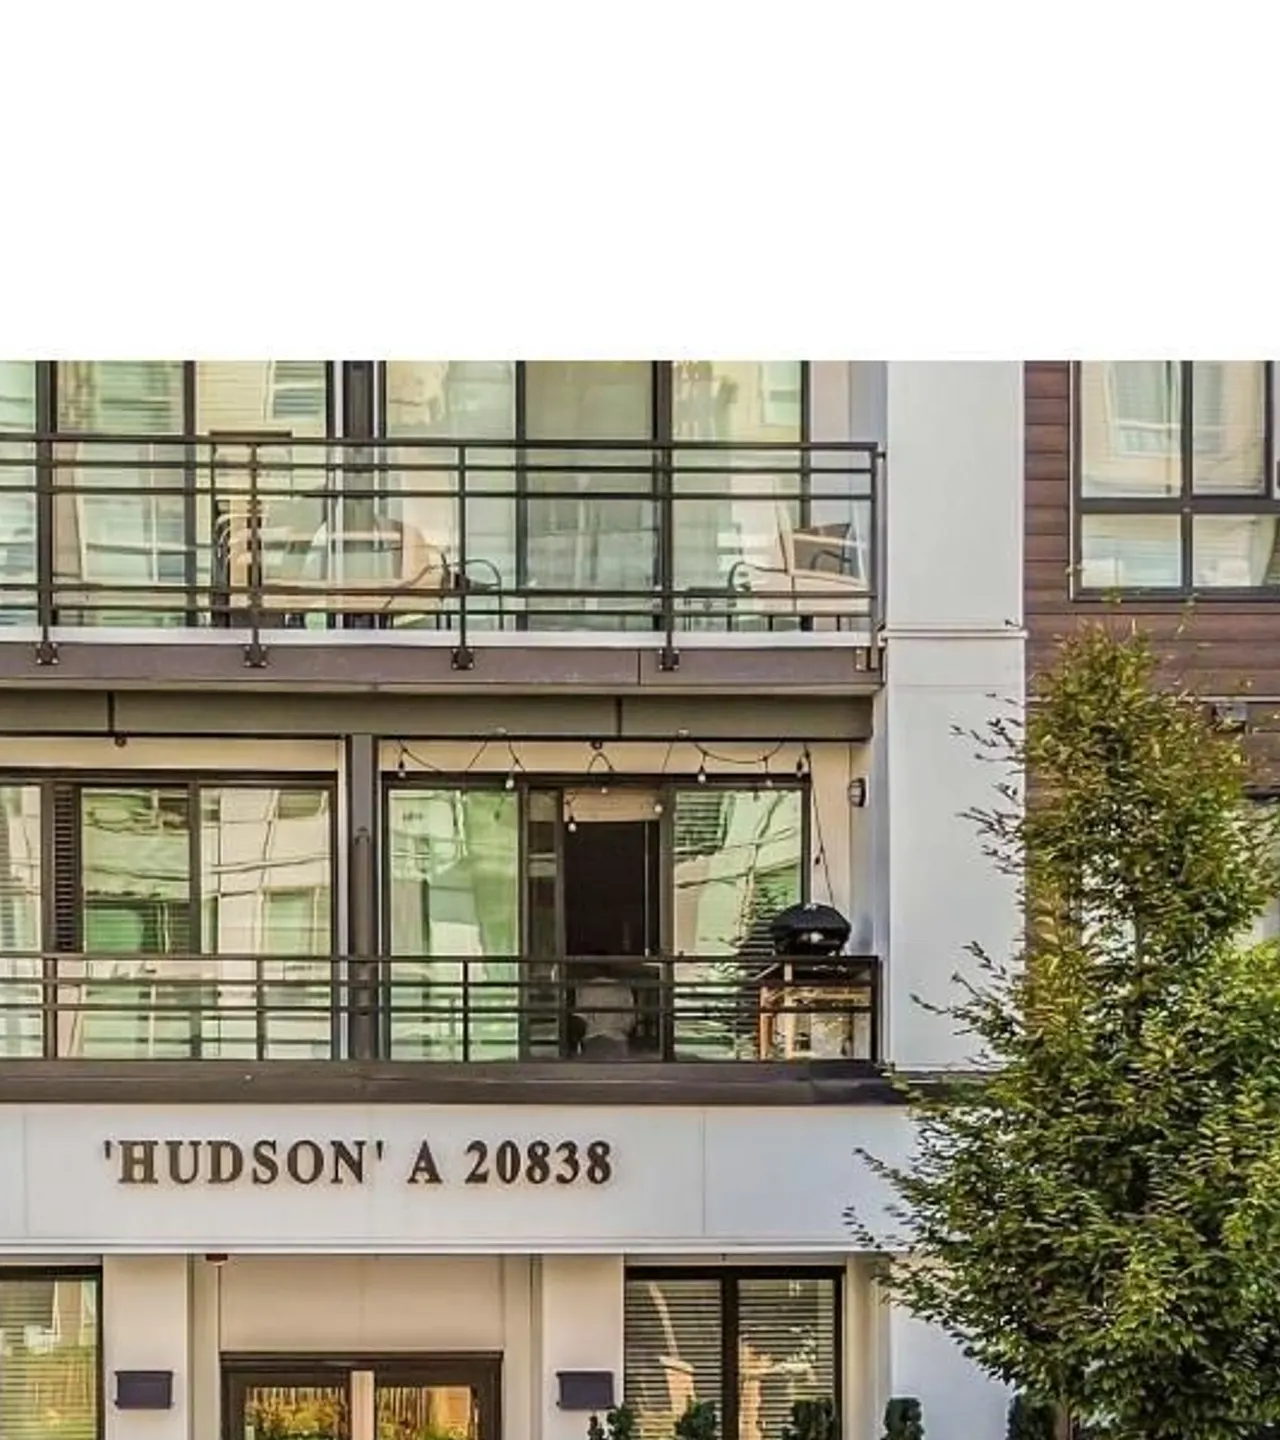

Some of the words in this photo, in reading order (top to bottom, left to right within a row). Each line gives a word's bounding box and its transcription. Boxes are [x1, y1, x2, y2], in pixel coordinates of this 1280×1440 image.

[103, 1139, 383, 1184] 'HUDSON'
[407, 1139, 443, 1184] A
[465, 1139, 612, 1184] 20838
